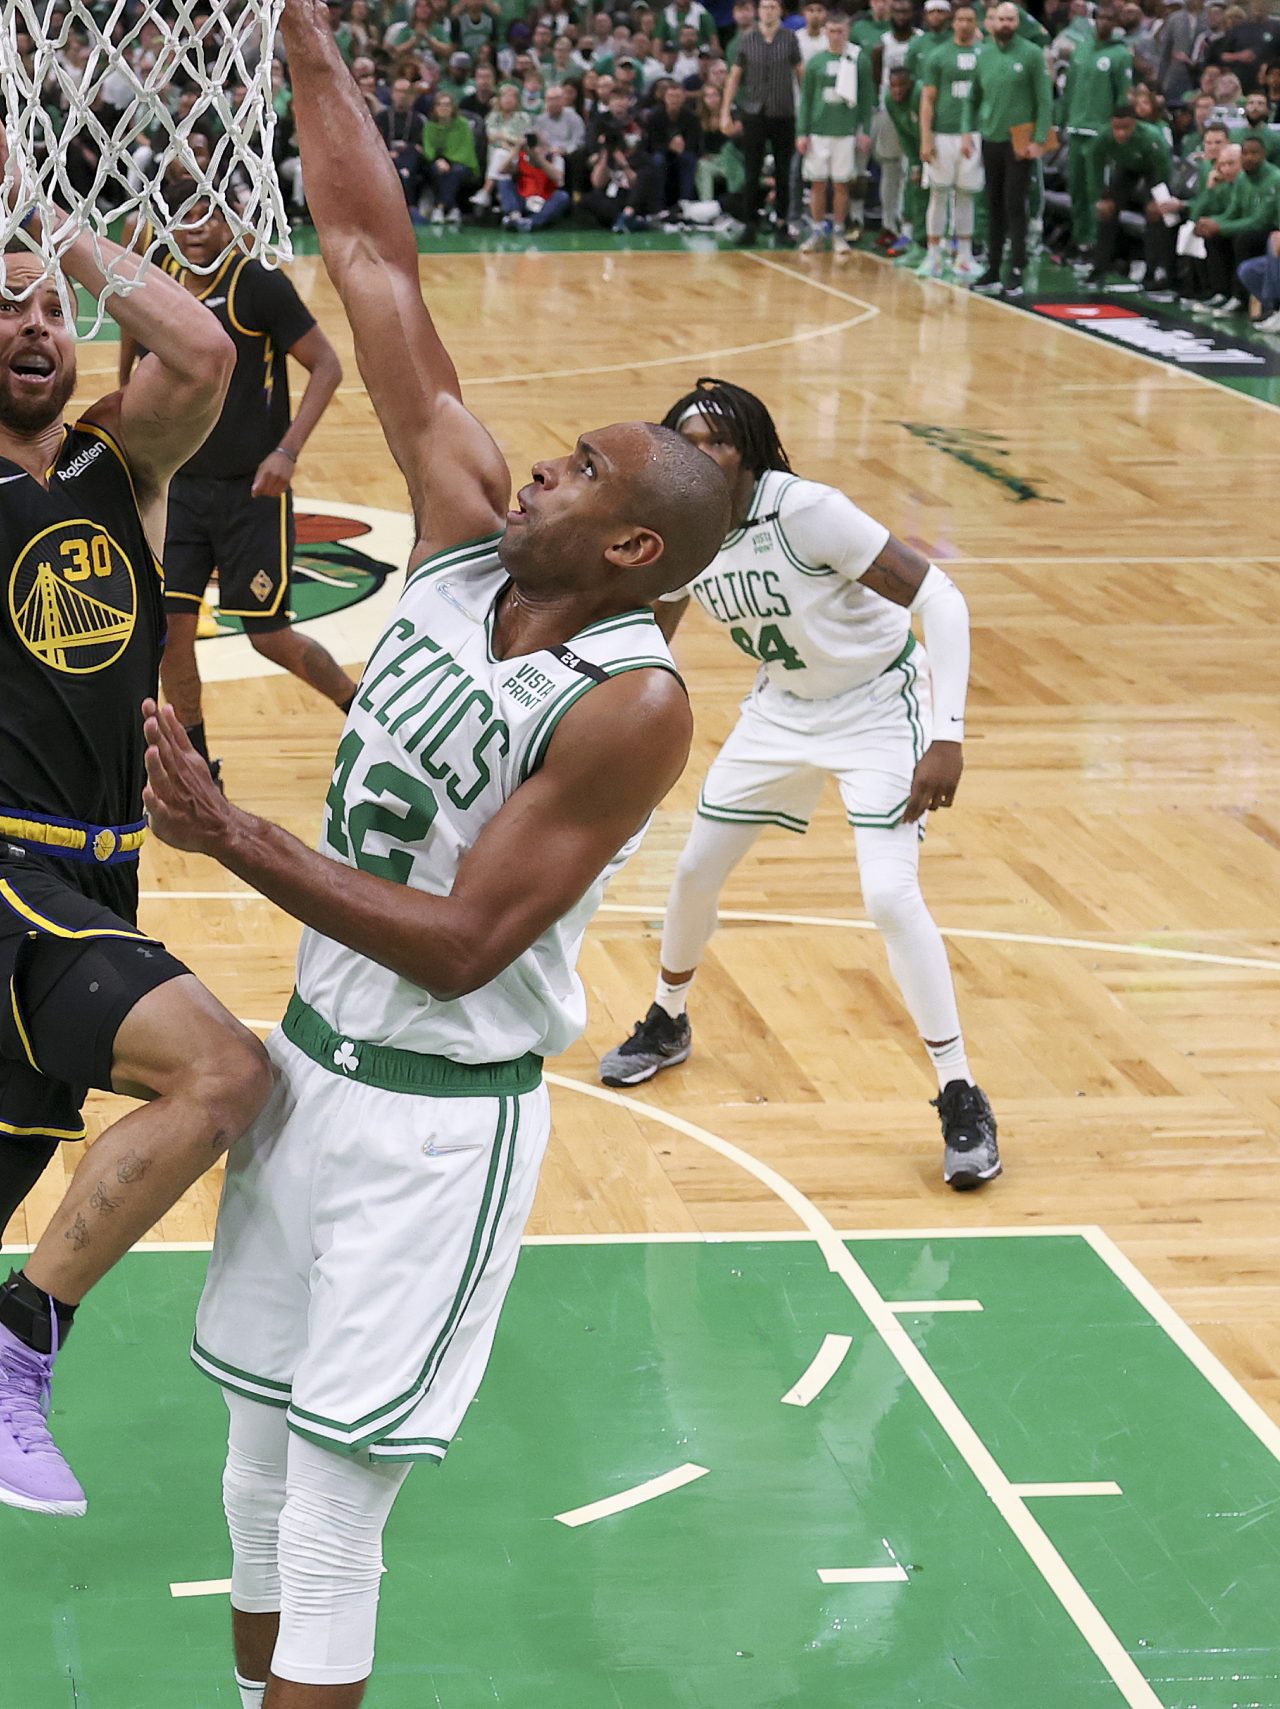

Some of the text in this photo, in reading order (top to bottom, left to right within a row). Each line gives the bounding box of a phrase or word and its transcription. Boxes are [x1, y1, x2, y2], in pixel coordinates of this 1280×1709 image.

[56, 441, 107, 482] Rakuten
[59, 535, 112, 582] 30
[693, 570, 792, 623] CELTICS
[515, 662, 556, 699] VISTA
[560, 652, 581, 669] 24
[355, 617, 510, 811] CELTICS
[501, 677, 542, 710] PRINT
[325, 728, 439, 885] 42
